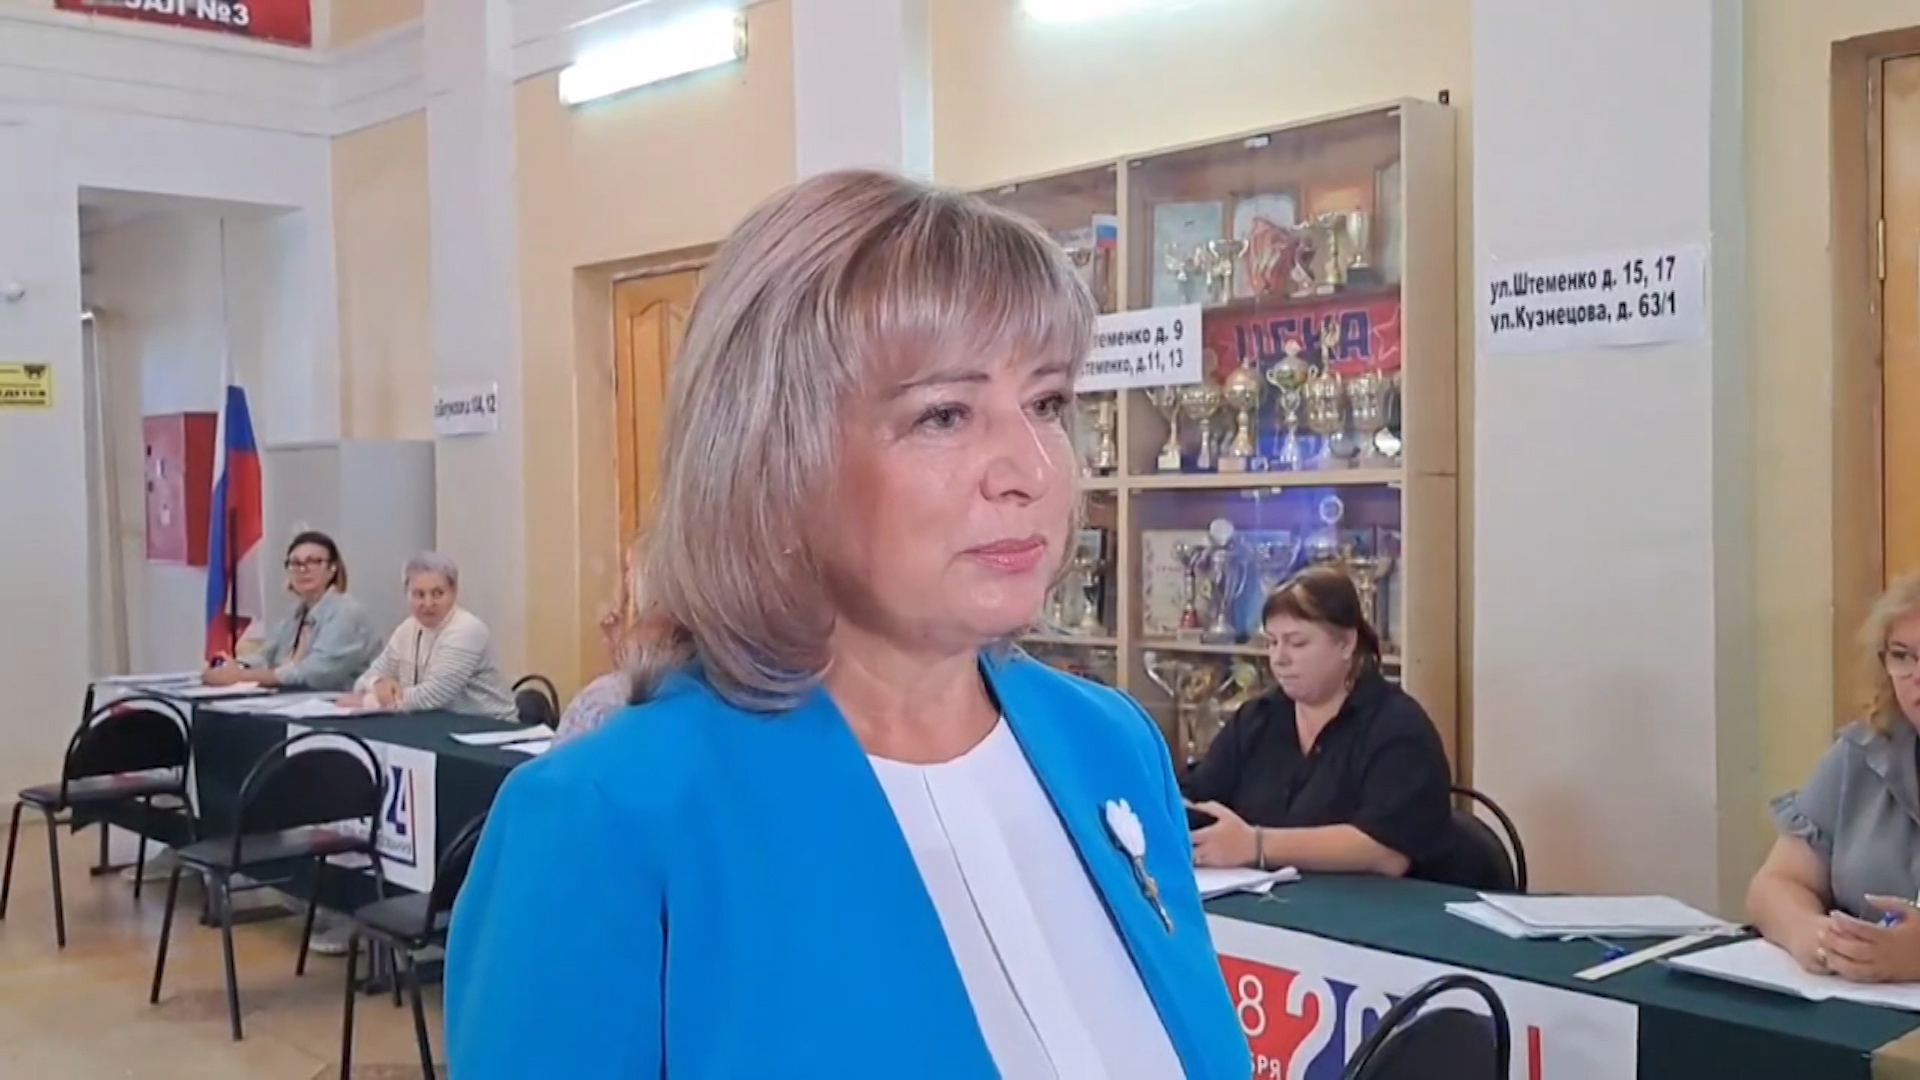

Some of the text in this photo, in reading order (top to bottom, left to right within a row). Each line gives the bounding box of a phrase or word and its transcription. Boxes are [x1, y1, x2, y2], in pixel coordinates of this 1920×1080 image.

[197, 0, 249, 26] №3
[1490, 255, 1676, 305] ул.Штеменко д. 15, 17
[1490, 290, 1676, 333] ул.Кузнецова, д. 63/1
[1093, 319, 1183, 347] теменко д. 9
[1234, 309, 1372, 366] ЦСКА
[1081, 358, 1134, 377] теменко,
[1169, 347, 1183, 369] 13
[1251, 1052, 1282, 1080] РЯ
